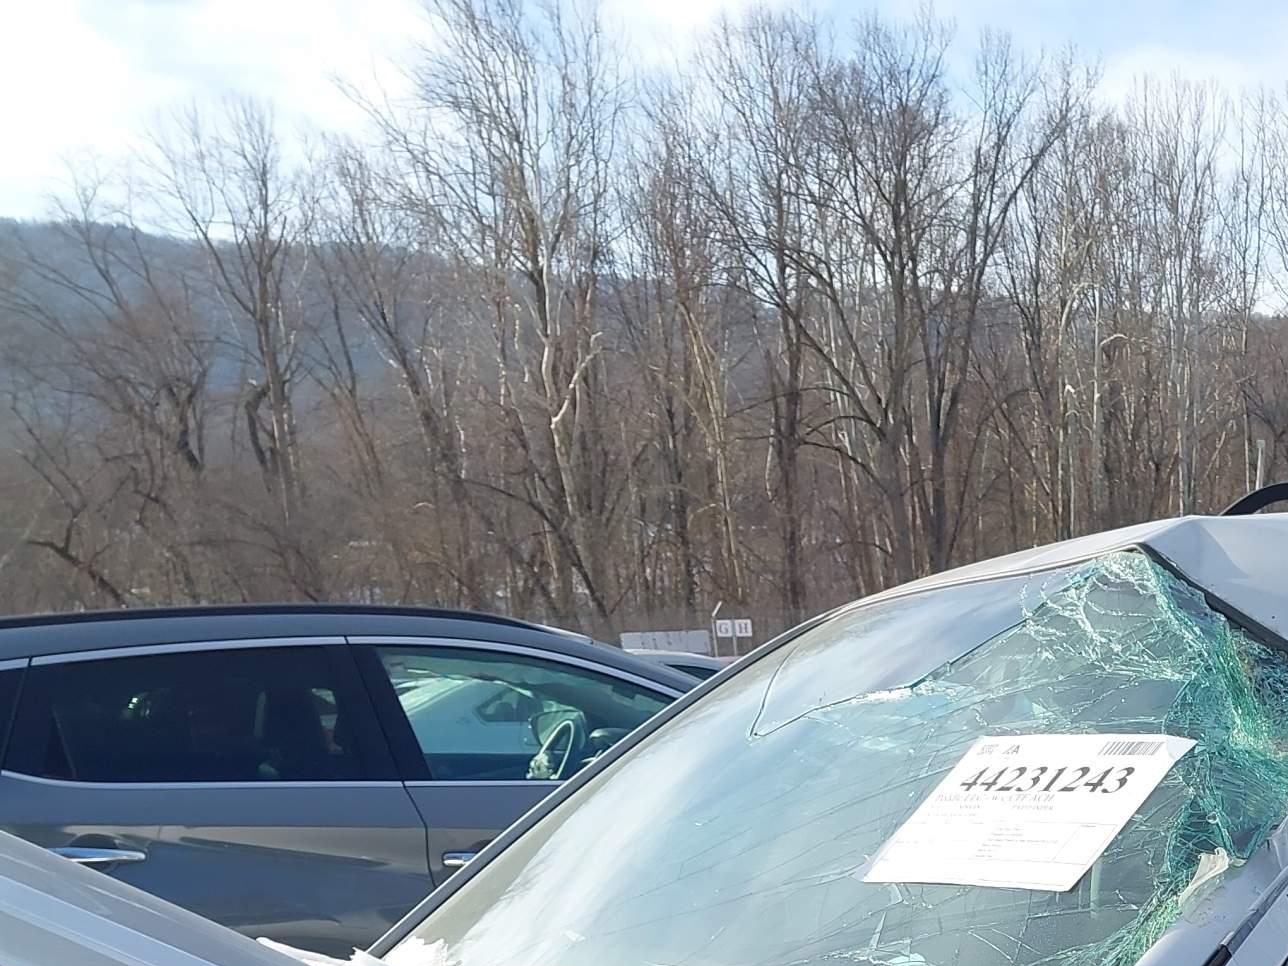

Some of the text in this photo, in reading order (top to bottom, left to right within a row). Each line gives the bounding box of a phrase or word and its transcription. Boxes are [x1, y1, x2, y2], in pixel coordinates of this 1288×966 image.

[719, 622, 729, 634] G
[738, 622, 748, 634] H
[960, 766, 1136, 794] 44231243
